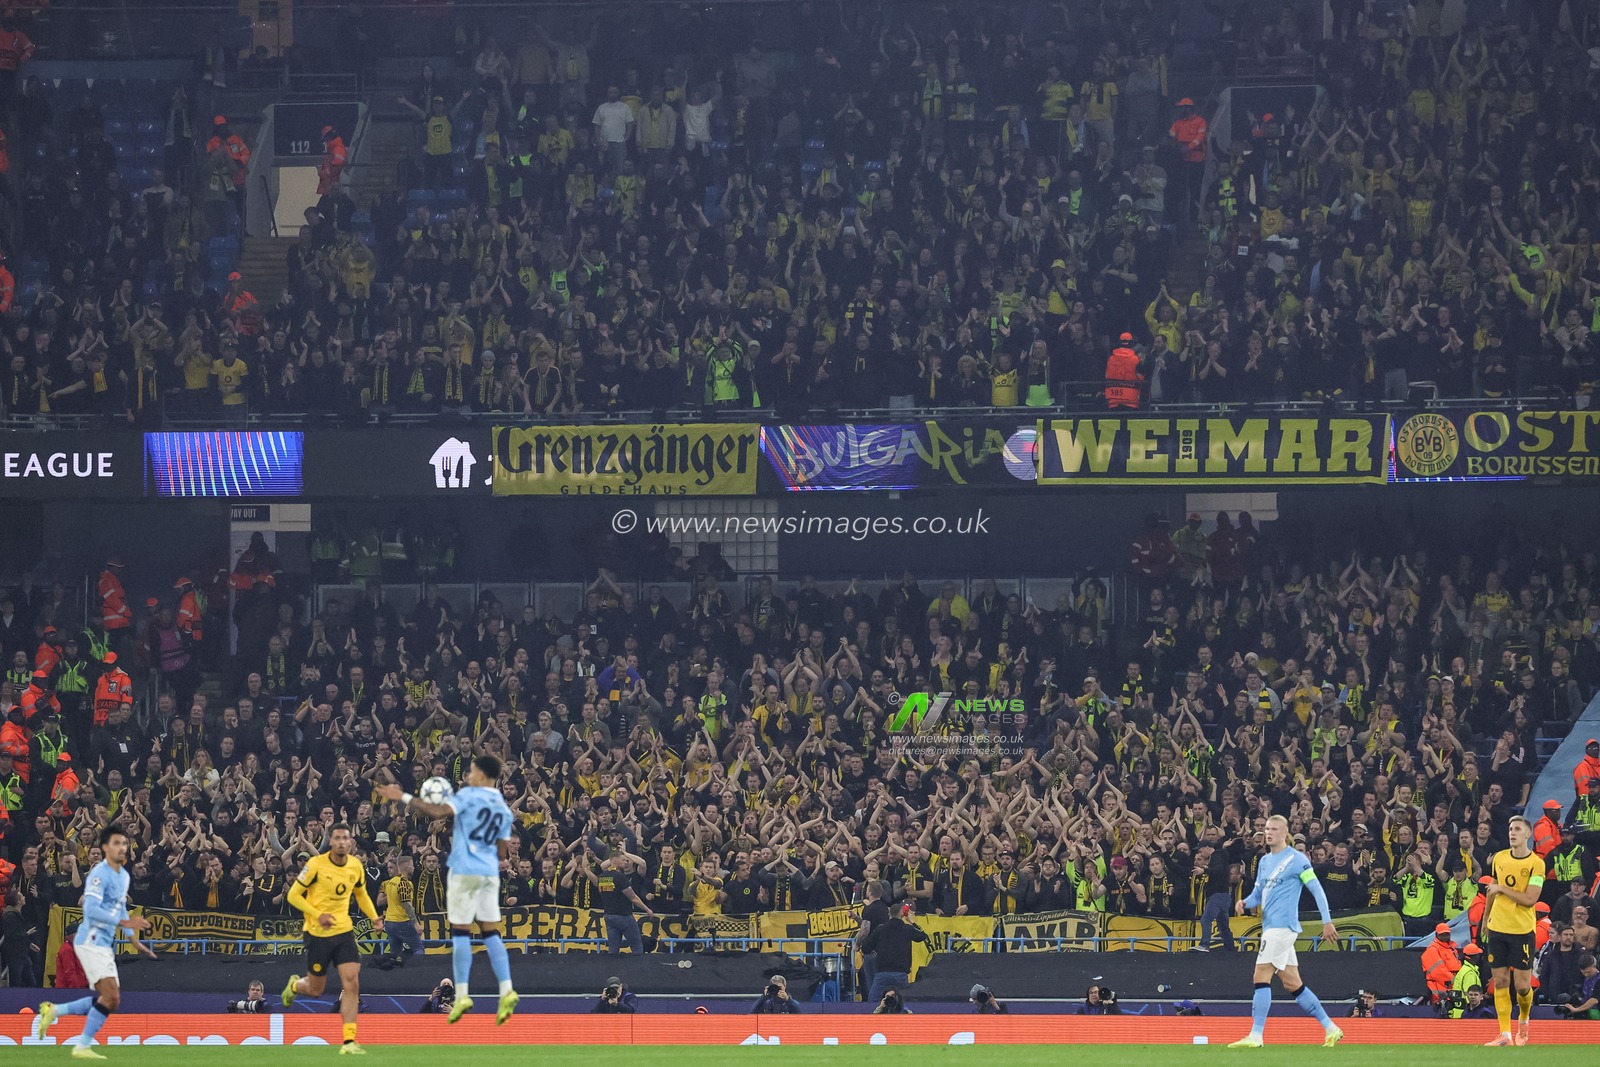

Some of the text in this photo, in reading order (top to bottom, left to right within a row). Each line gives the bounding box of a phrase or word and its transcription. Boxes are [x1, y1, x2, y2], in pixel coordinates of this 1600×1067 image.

[290, 140, 310, 154] 112
[1050, 419, 1373, 474] WEIMAR
[1182, 429, 1194, 460] 1909
[1415, 429, 1443, 452] BVB
[497, 425, 756, 486] Grenzgänger
[1423, 451, 1433, 460] 09
[560, 484, 687, 496] GILDEHAUS
[243, 508, 257, 518] OUT
[468, 807, 503, 846] 26
[176, 914, 254, 931] SUPPORTERS
[1522, 944, 1530, 958] 4
